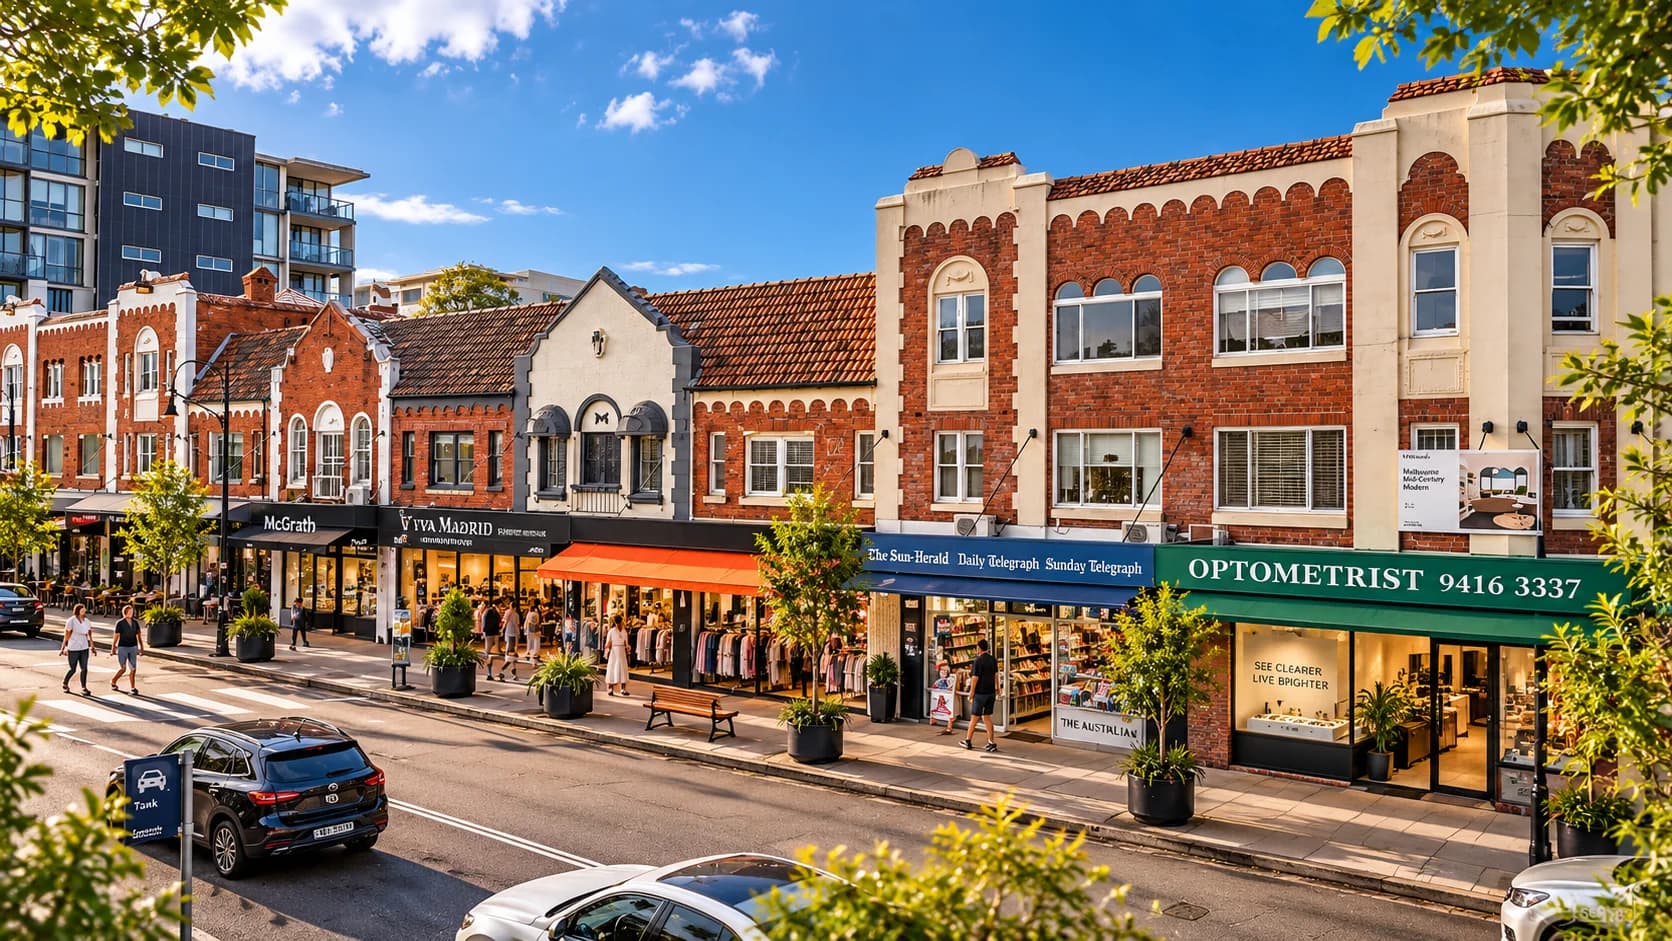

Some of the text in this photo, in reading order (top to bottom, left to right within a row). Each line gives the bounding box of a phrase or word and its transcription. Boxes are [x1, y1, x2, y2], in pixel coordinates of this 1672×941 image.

[264, 515, 316, 533] McGrath
[438, 516, 493, 536] MADRID
[867, 548, 1143, 576] The Sun-Herald Daily Telegraph Sunday Telegraph
[1188, 558, 1582, 600] OPTOMETRIST 9416 3337
[1254, 661, 1322, 676] SEE CLEARER
[1252, 674, 1274, 685] LIVE
[1060, 717, 1137, 738] THE AUSTRALIAN
